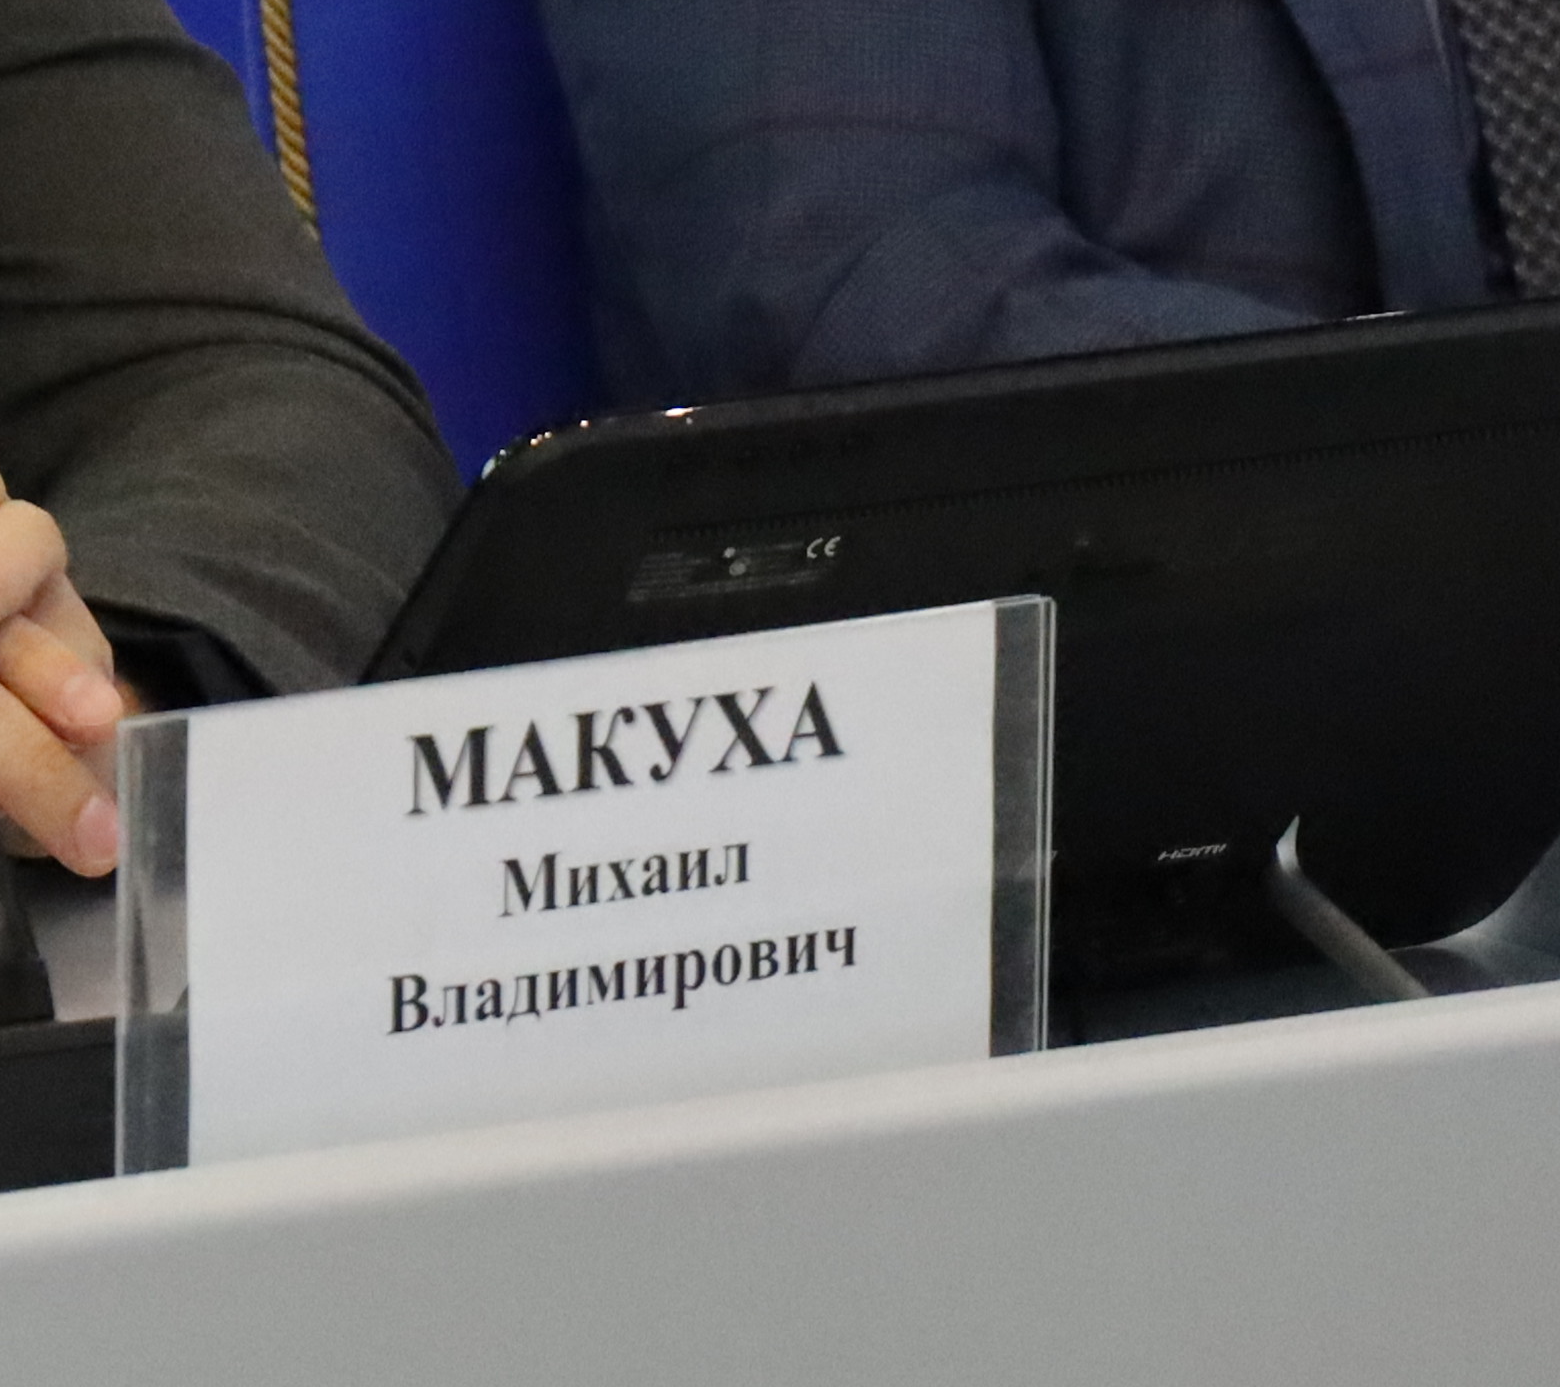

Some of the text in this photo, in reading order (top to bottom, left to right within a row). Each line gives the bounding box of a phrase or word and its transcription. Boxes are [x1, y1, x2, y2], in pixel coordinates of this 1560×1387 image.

[404, 680, 845, 818] МАКУХА
[499, 839, 752, 918] Михаил
[386, 925, 859, 1036] Владимирович
